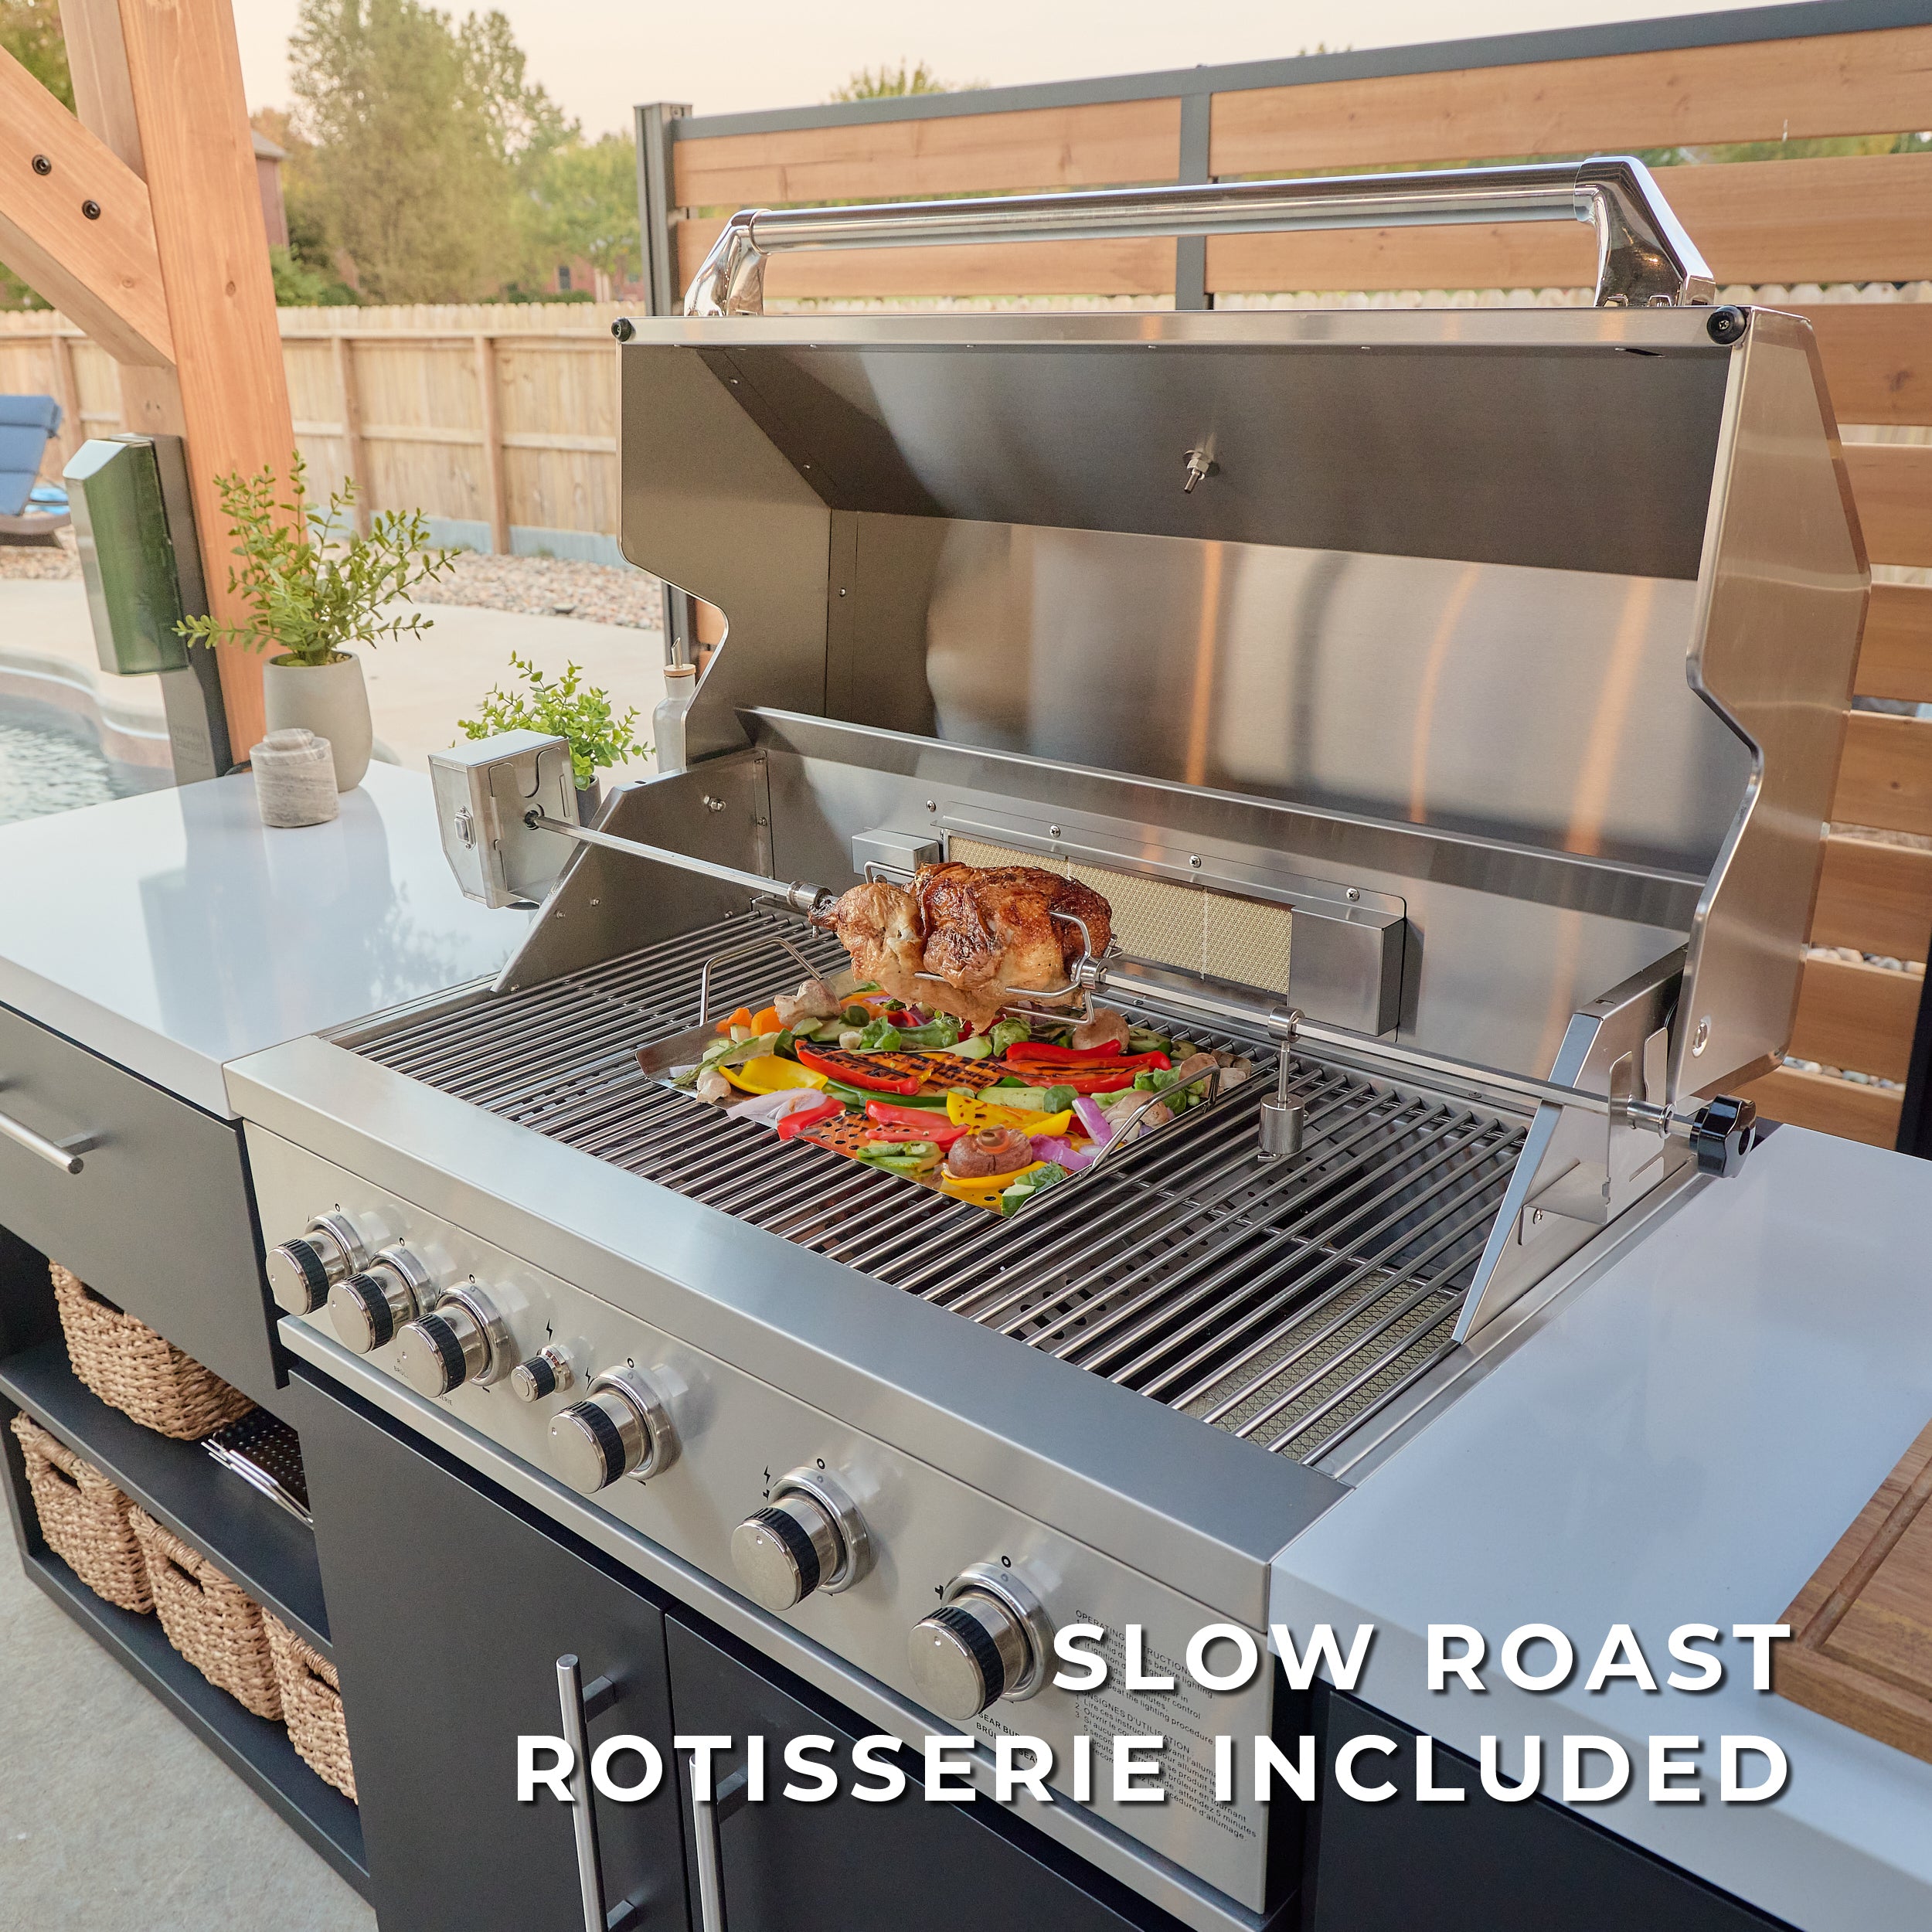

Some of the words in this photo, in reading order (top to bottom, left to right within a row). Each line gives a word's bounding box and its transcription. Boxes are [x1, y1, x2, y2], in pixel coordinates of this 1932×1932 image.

[1075, 1610, 1125, 1641] OPERATING
[1153, 1661, 1179, 1679] before
[1083, 1699, 1098, 1711] Lire
[1100, 1709, 1113, 1719] ces
[1125, 1692, 1138, 1703] the
[1140, 1699, 1169, 1722] lighting
[1172, 1701, 1201, 1719] control
[1083, 1707, 1107, 1725] Ouvrir
[1108, 1721, 1115, 1730] le
[1177, 1761, 1206, 1781] allumer
[1179, 1771, 1206, 1791] produit
[1199, 1792, 1209, 1801] en
[1179, 1790, 1213, 1812] attendez
[1223, 1816, 1256, 1837] minutes
